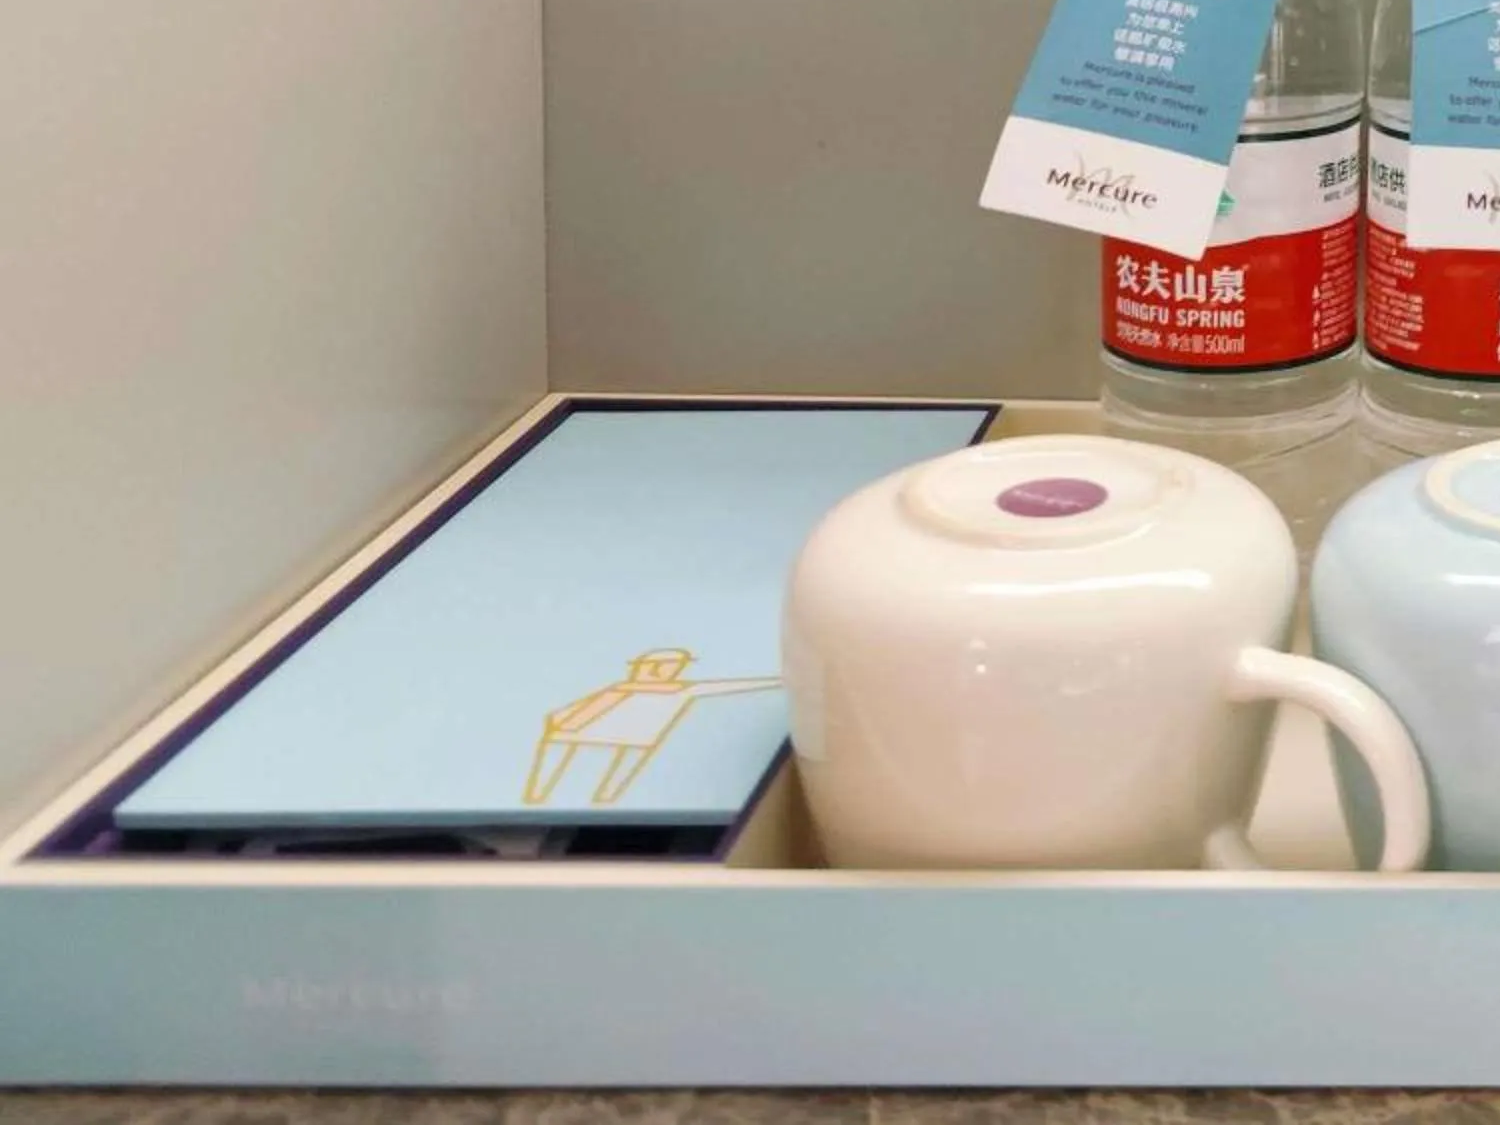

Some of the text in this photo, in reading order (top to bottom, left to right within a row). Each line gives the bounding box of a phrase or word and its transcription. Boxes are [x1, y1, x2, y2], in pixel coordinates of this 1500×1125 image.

[1047, 168, 1158, 209] Mercure
[1116, 254, 1246, 304] 农夫山泉
[1116, 297, 1246, 328] NONGFU SPRING
